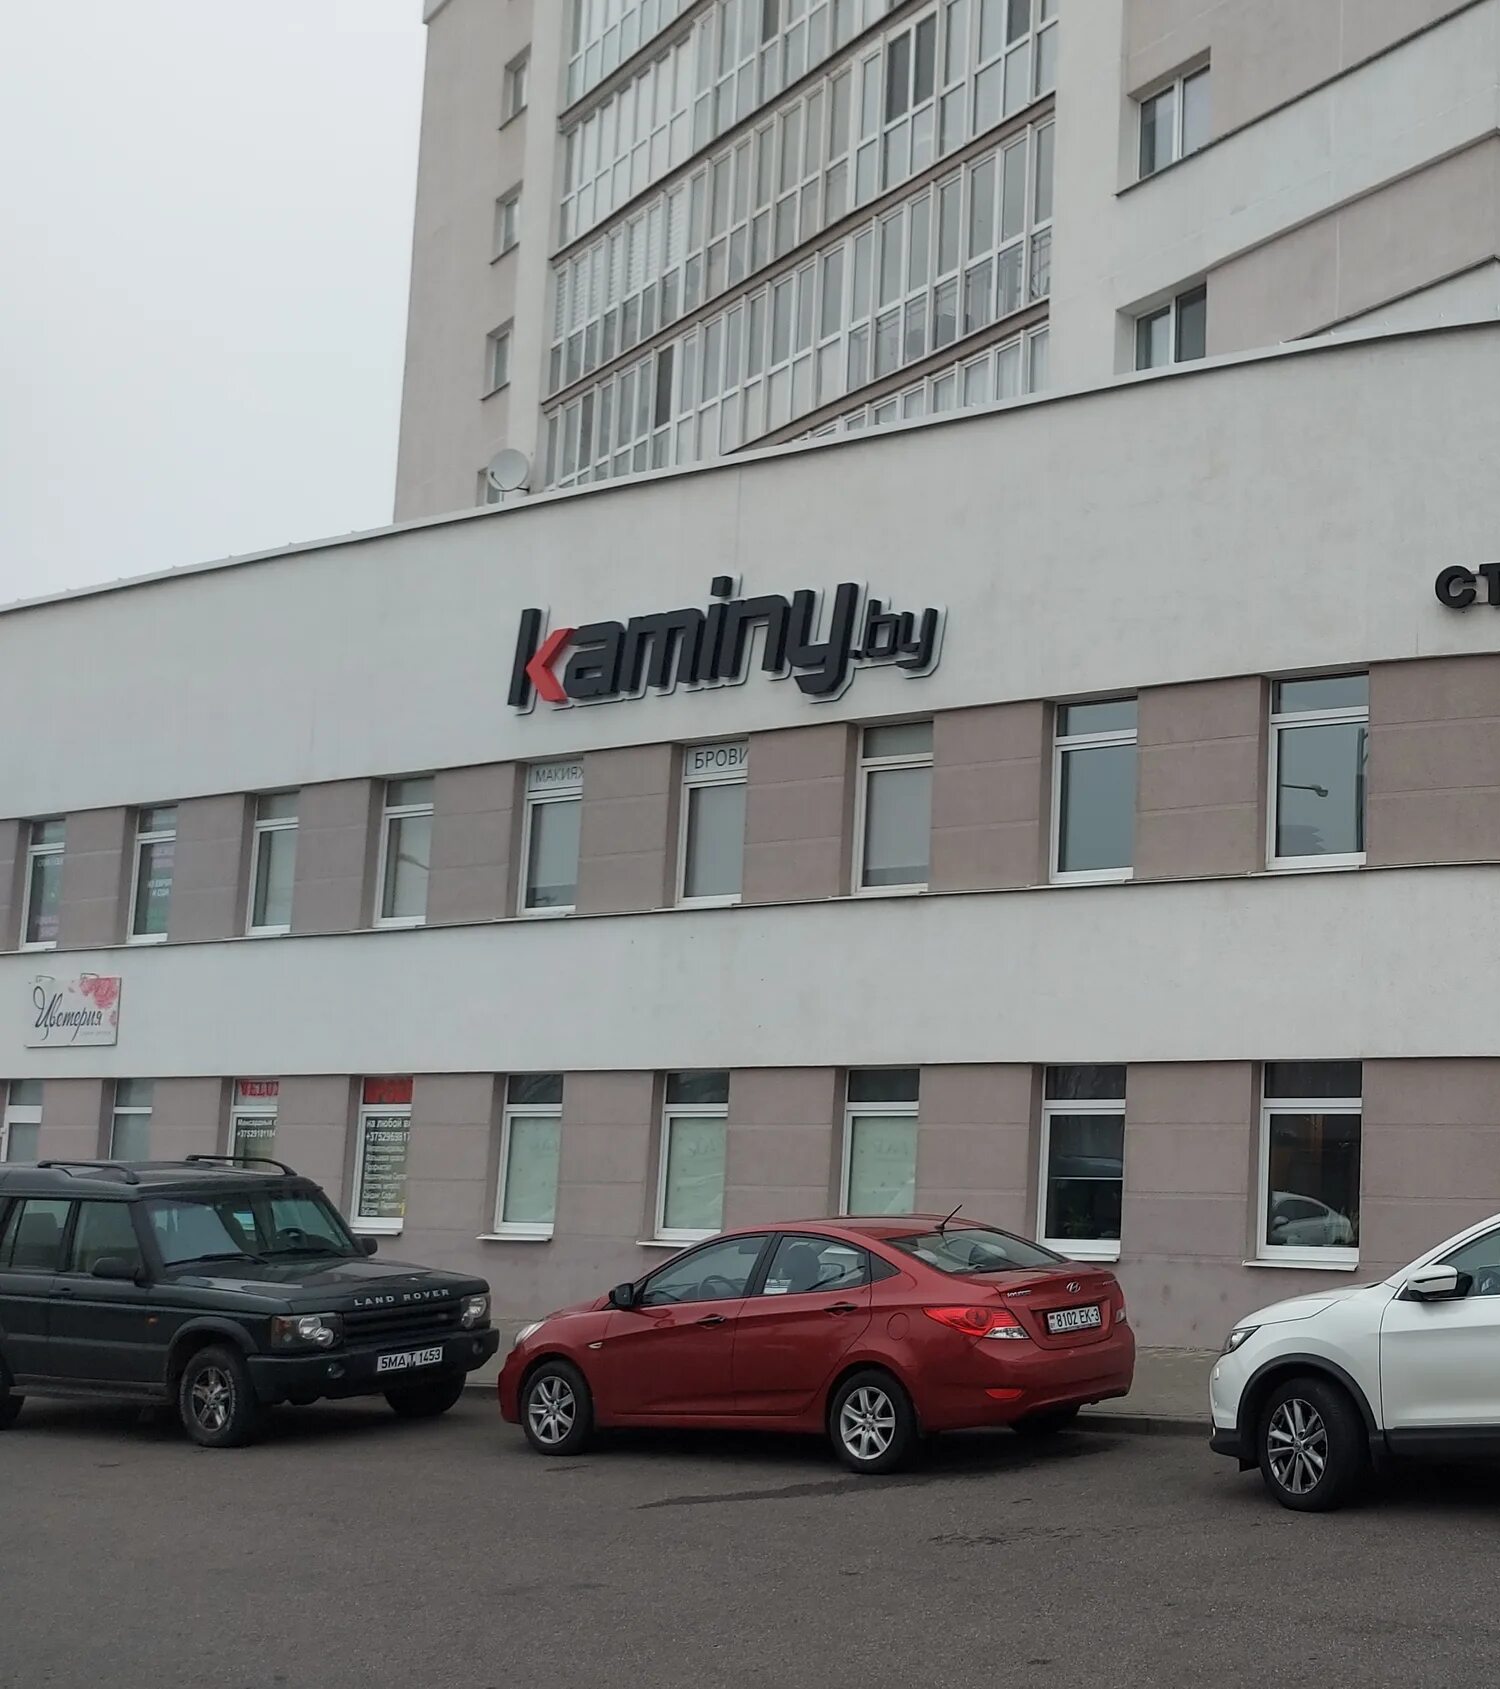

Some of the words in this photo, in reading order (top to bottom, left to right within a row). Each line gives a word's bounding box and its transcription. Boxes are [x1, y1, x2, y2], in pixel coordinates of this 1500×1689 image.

[508, 575, 940, 706] kaminy.by
[354, 1295, 395, 1306] LAND
[403, 1288, 450, 1301] ROVER
[1057, 1311, 1079, 1327] 8102
